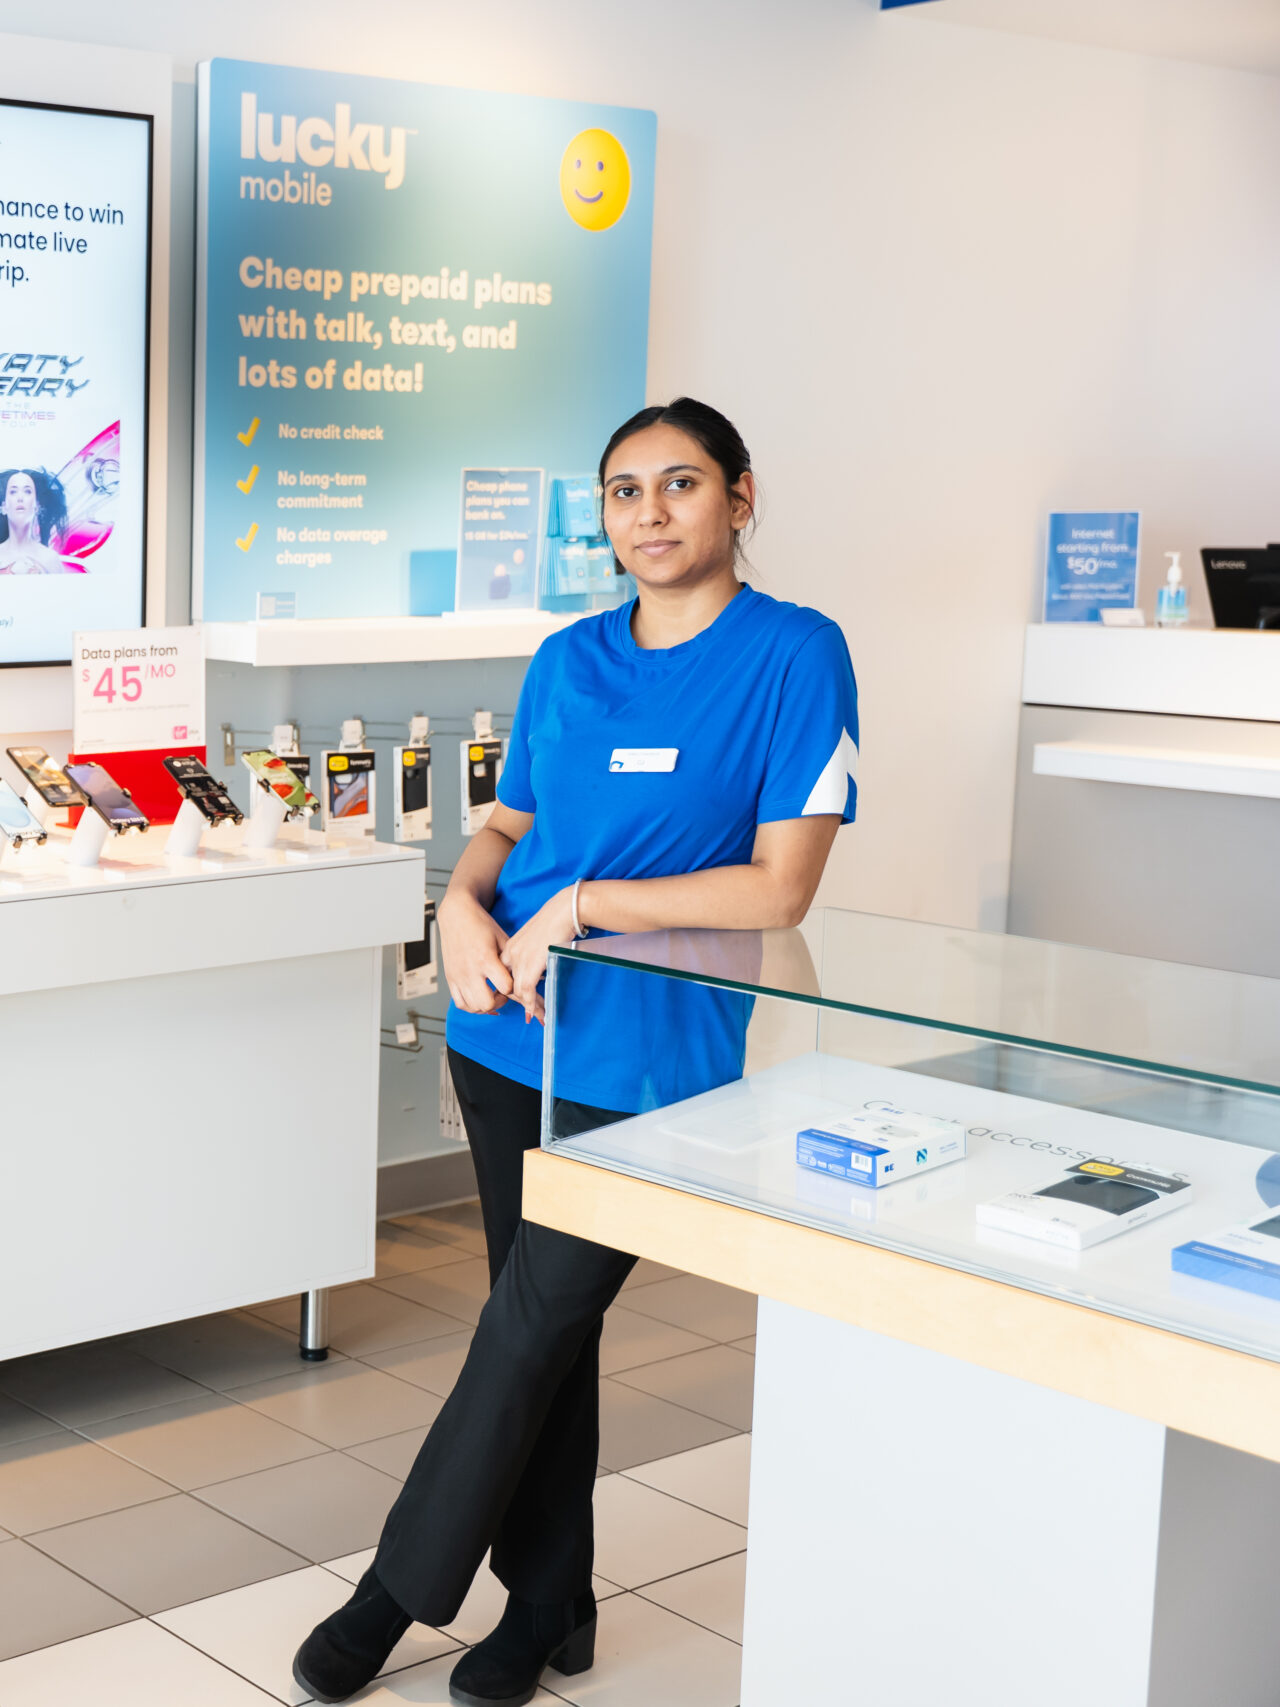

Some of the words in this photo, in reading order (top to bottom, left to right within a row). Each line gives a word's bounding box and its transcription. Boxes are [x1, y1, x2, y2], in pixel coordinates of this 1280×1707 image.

[240, 91, 407, 192] lucky
[240, 172, 333, 209] mobile
[63, 201, 85, 222] to
[88, 203, 125, 226] win
[53, 230, 89, 254] live
[239, 255, 343, 301] Cheap
[350, 266, 467, 306] prepaid
[473, 271, 553, 312] plans
[239, 307, 308, 341] with
[314, 313, 383, 350] talk,
[390, 317, 457, 353] text,
[462, 321, 517, 350] and
[239, 357, 298, 389] lots
[303, 359, 336, 390] of
[343, 361, 425, 394] data!
[278, 424, 298, 440] No
[301, 424, 341, 440] credit
[344, 426, 384, 441] check
[277, 470, 297, 487] No
[300, 471, 367, 490] long-term
[277, 494, 363, 510] commitment
[276, 526, 296, 543] No
[299, 527, 330, 544] data
[1071, 528, 1115, 539] Internet
[1056, 543, 1099, 555] starting
[1101, 542, 1129, 553] from
[276, 550, 332, 567] charges
[1211, 559, 1247, 570] Lenovo
[81, 648, 111, 660] Data
[114, 647, 147, 662] plans
[150, 644, 178, 657] from
